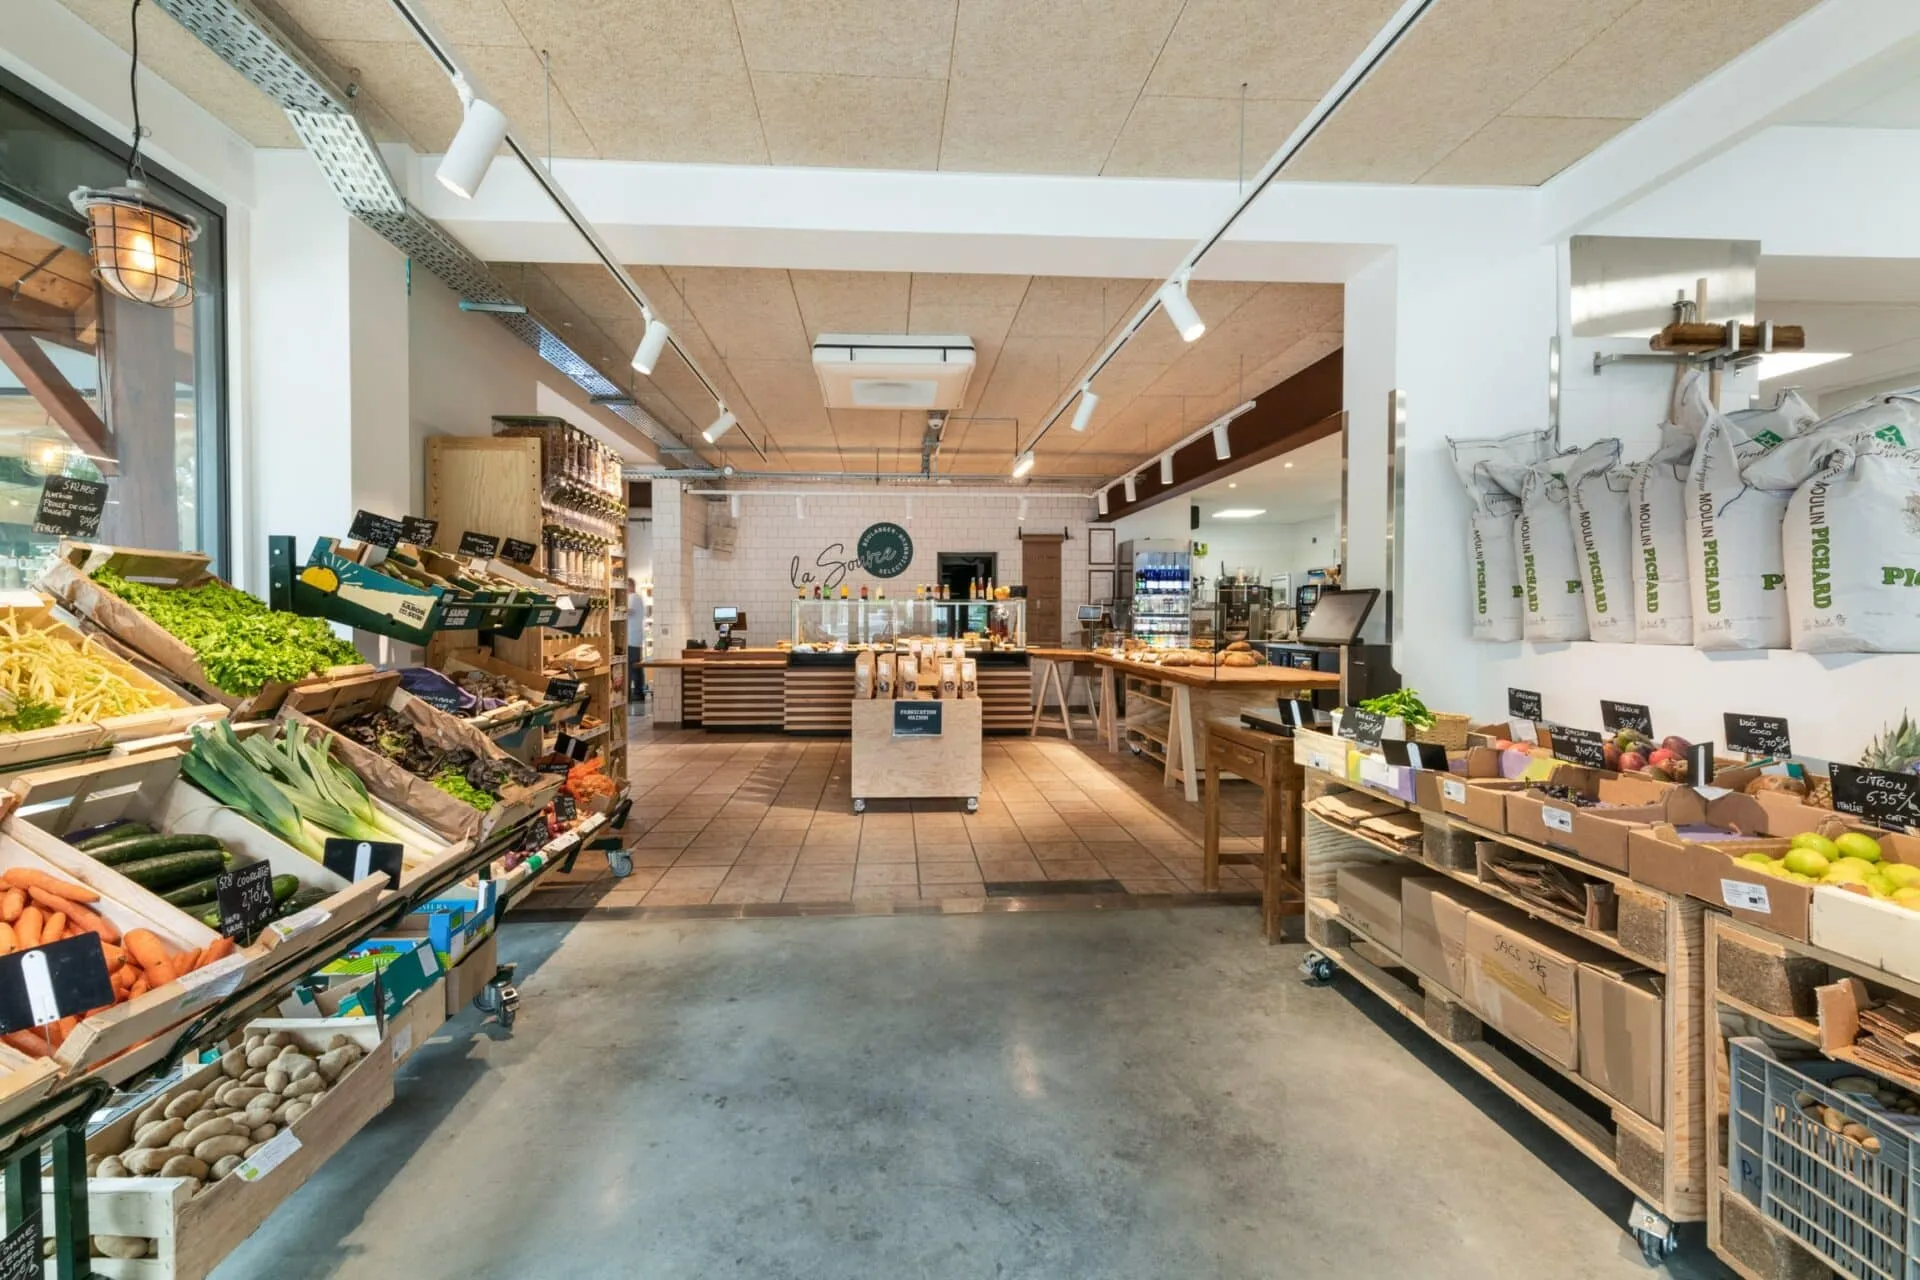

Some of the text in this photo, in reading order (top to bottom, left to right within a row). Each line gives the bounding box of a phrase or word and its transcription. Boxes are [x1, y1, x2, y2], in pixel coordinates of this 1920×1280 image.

[1473, 529, 1483, 560] MOULIN
[1639, 503, 1652, 547] MOULIN
[1699, 492, 1714, 538] MOULIN
[1477, 559, 1487, 615] PICHARD
[1520, 516, 1539, 613] MOULIN PICHARD
[1579, 511, 1596, 553] MOULIN
[1588, 551, 1608, 614] PICHARD
[1642, 546, 1659, 613] PICHARD
[1703, 539, 1721, 614] PICHARD
[1811, 526, 1832, 609] PICHARD
[1856, 772, 1908, 792] CITRON
